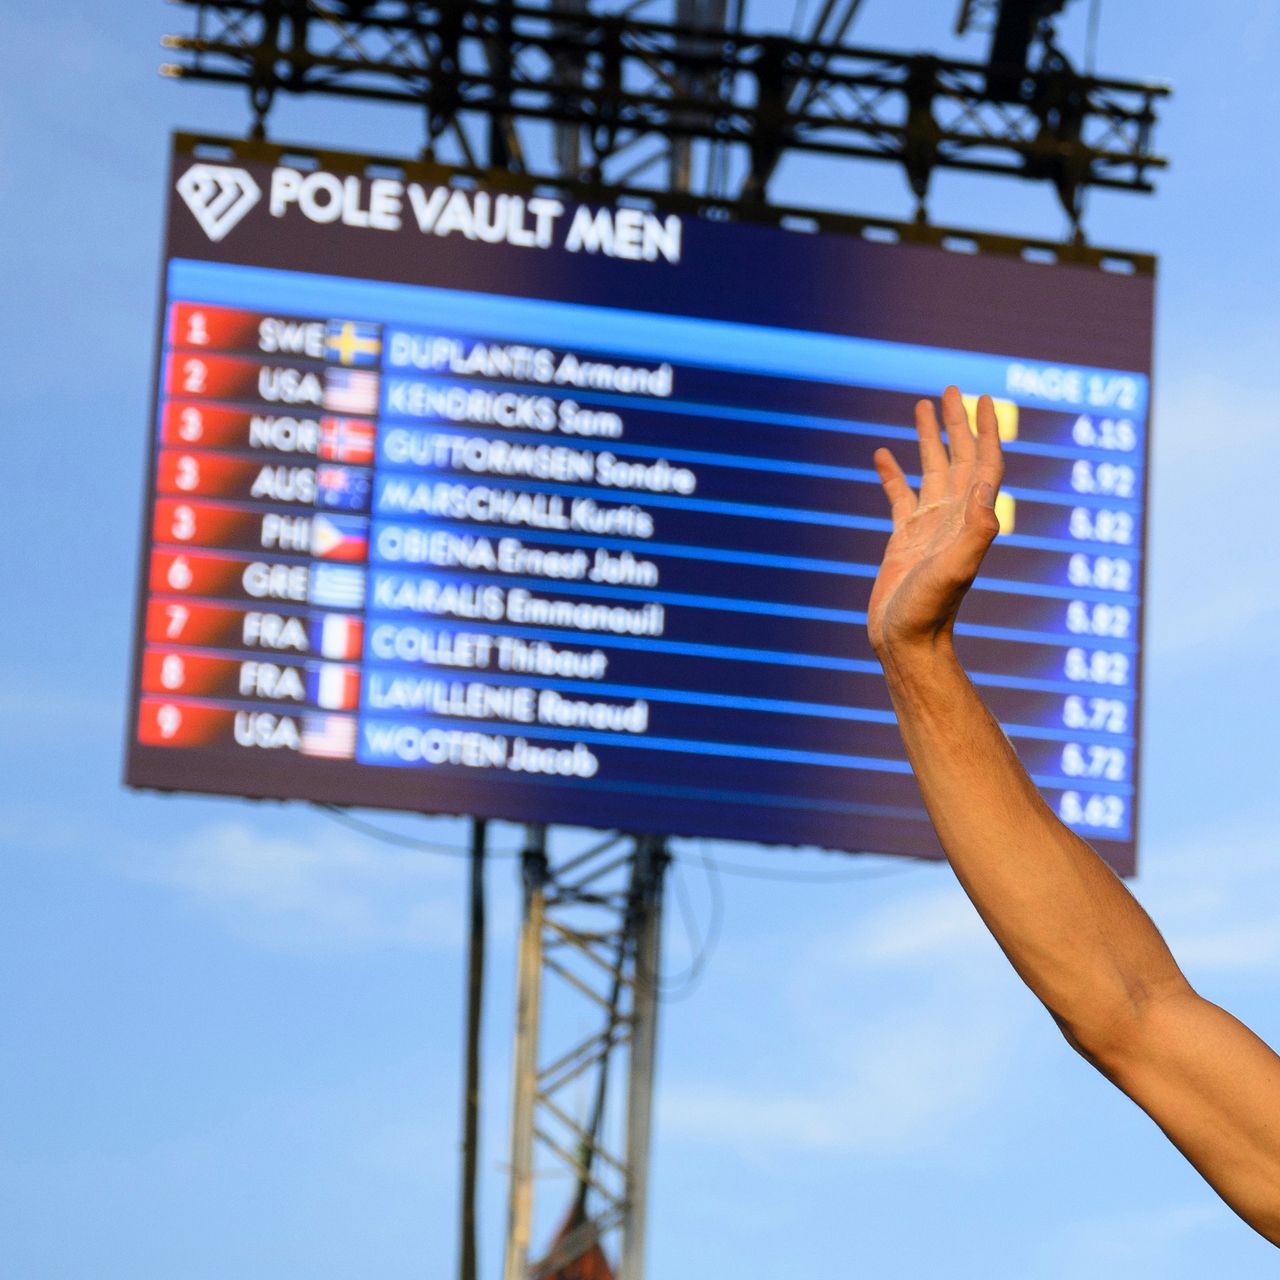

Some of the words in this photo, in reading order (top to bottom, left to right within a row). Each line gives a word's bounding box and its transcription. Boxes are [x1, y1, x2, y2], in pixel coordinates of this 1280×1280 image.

[269, 167, 402, 231] POLE
[407, 183, 564, 249] VAULT
[565, 204, 681, 264] MEN
[187, 311, 209, 345] 1
[258, 318, 325, 358] SWE
[389, 332, 554, 384] DUPLANTIS
[183, 358, 207, 393] 2
[258, 365, 323, 405] USA
[388, 381, 557, 432] KENDRICKS
[1006, 363, 1082, 403] PAGE
[1088, 375, 1136, 410] 1/2
[179, 407, 203, 442] 3
[249, 414, 320, 454] NOR
[383, 428, 594, 482] GUTTORMSEN
[596, 451, 696, 495] Sondre
[175, 455, 199, 491] 3
[251, 465, 317, 503] AUS
[379, 481, 570, 530] MARSCHALL
[171, 504, 196, 540] 3
[261, 513, 312, 551] PHI
[377, 526, 497, 571] OBIENA
[588, 547, 660, 587] John
[167, 554, 192, 590] 6
[242, 562, 308, 601] GRE
[374, 575, 504, 621] KARALIS
[165, 604, 189, 639] 7
[242, 612, 308, 651] FRA
[371, 624, 492, 669] COLLET
[161, 654, 185, 689] 8
[239, 661, 306, 701] FRA
[369, 674, 537, 723] LAVILLENIE
[157, 704, 181, 739] 9
[234, 710, 302, 750] USA
[365, 723, 507, 768] WOOTEN
